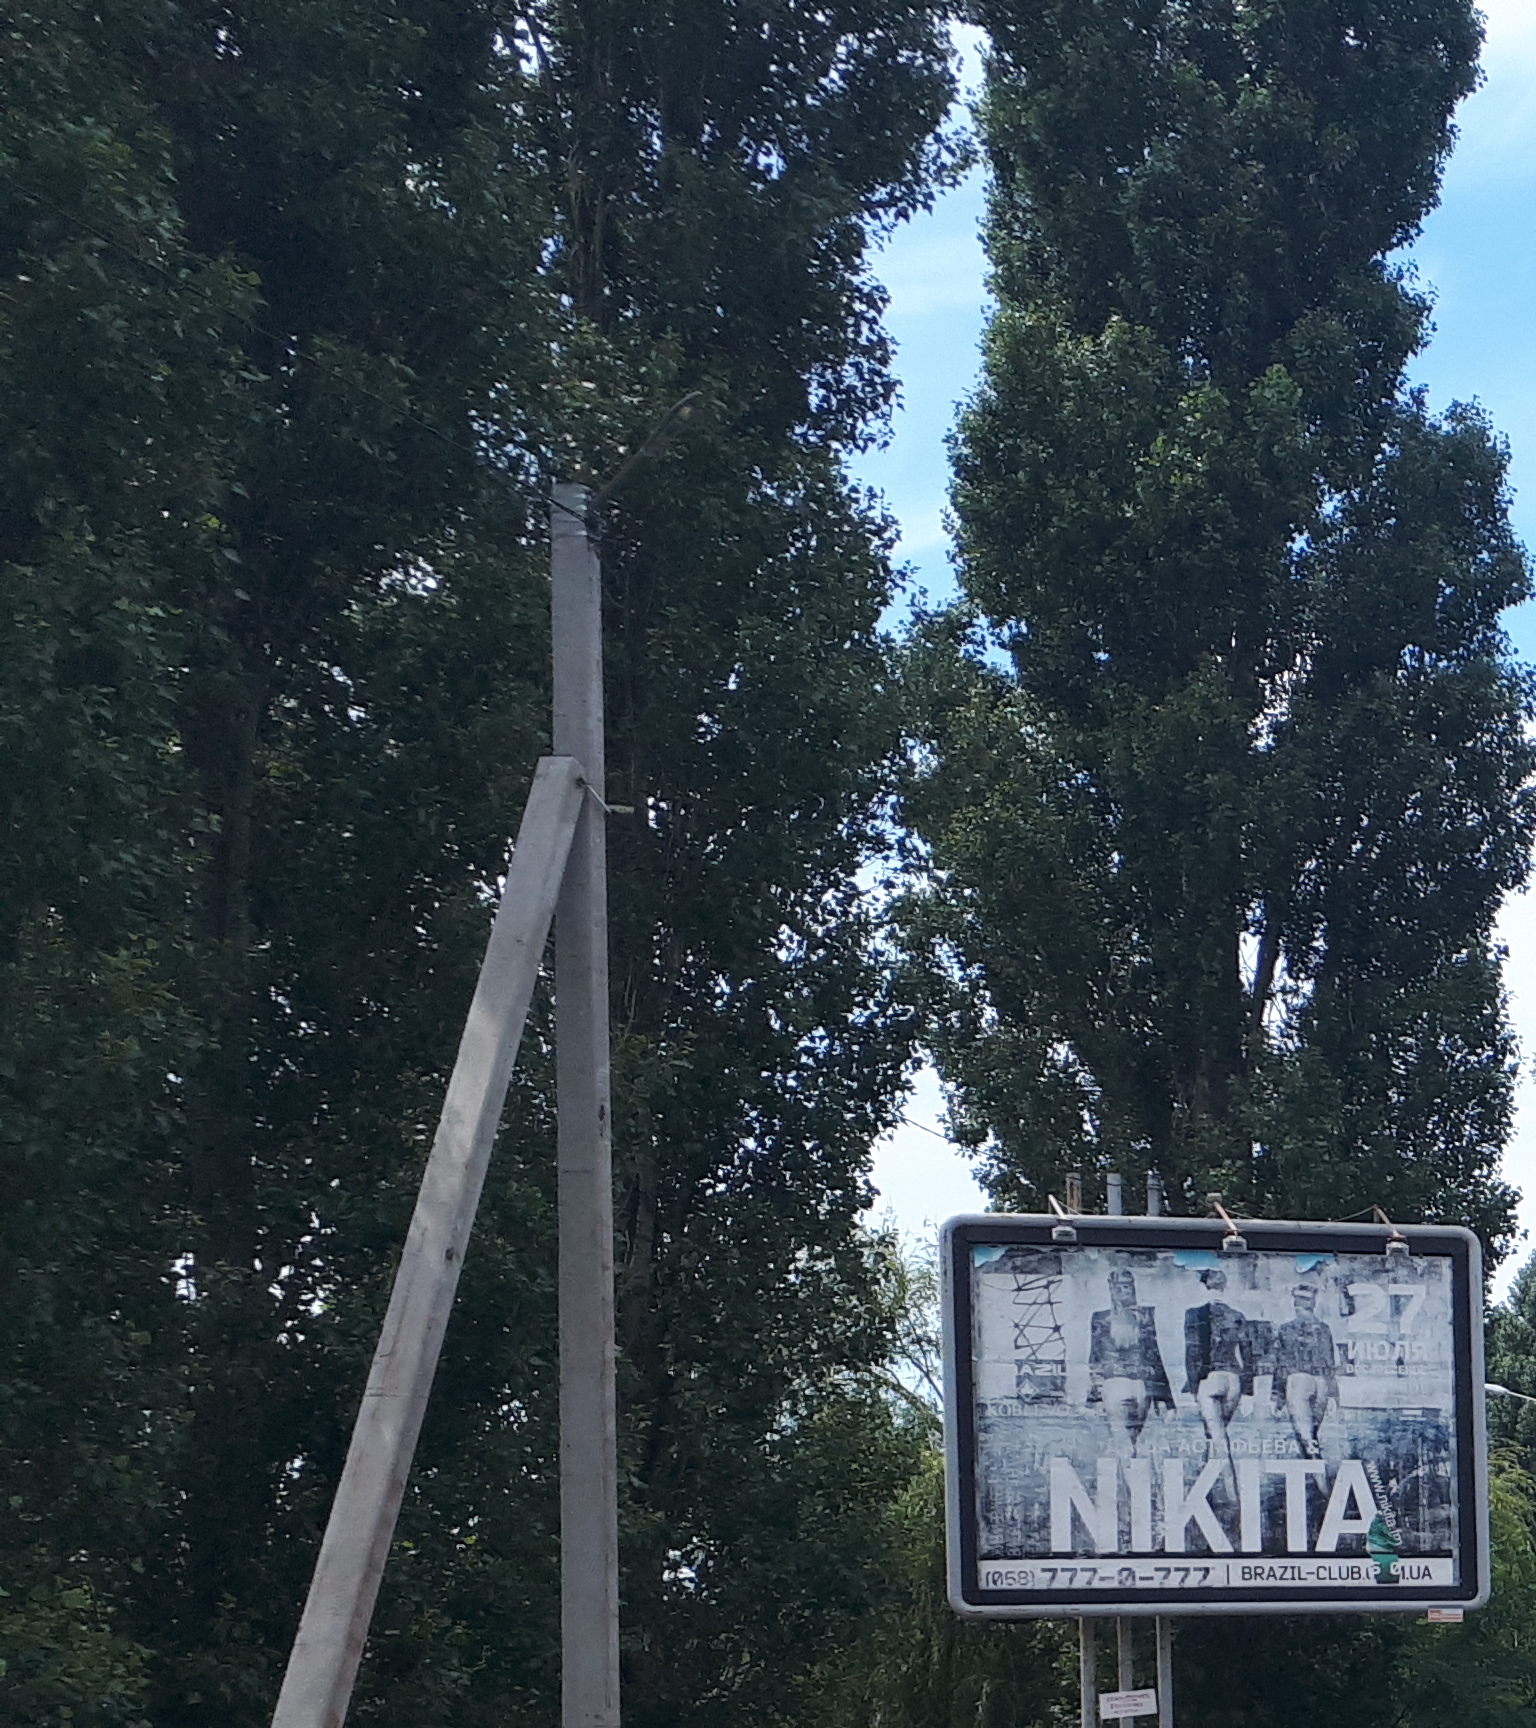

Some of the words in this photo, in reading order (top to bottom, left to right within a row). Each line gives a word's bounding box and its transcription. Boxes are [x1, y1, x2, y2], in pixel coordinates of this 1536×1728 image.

[1346, 1282, 1427, 1334] 27
[1050, 1457, 1382, 1553] NIKITA
[1040, 1566, 1211, 1588] 777-0-777
[1240, 1564, 1433, 1582] BRAZIL-CLUB..UA
